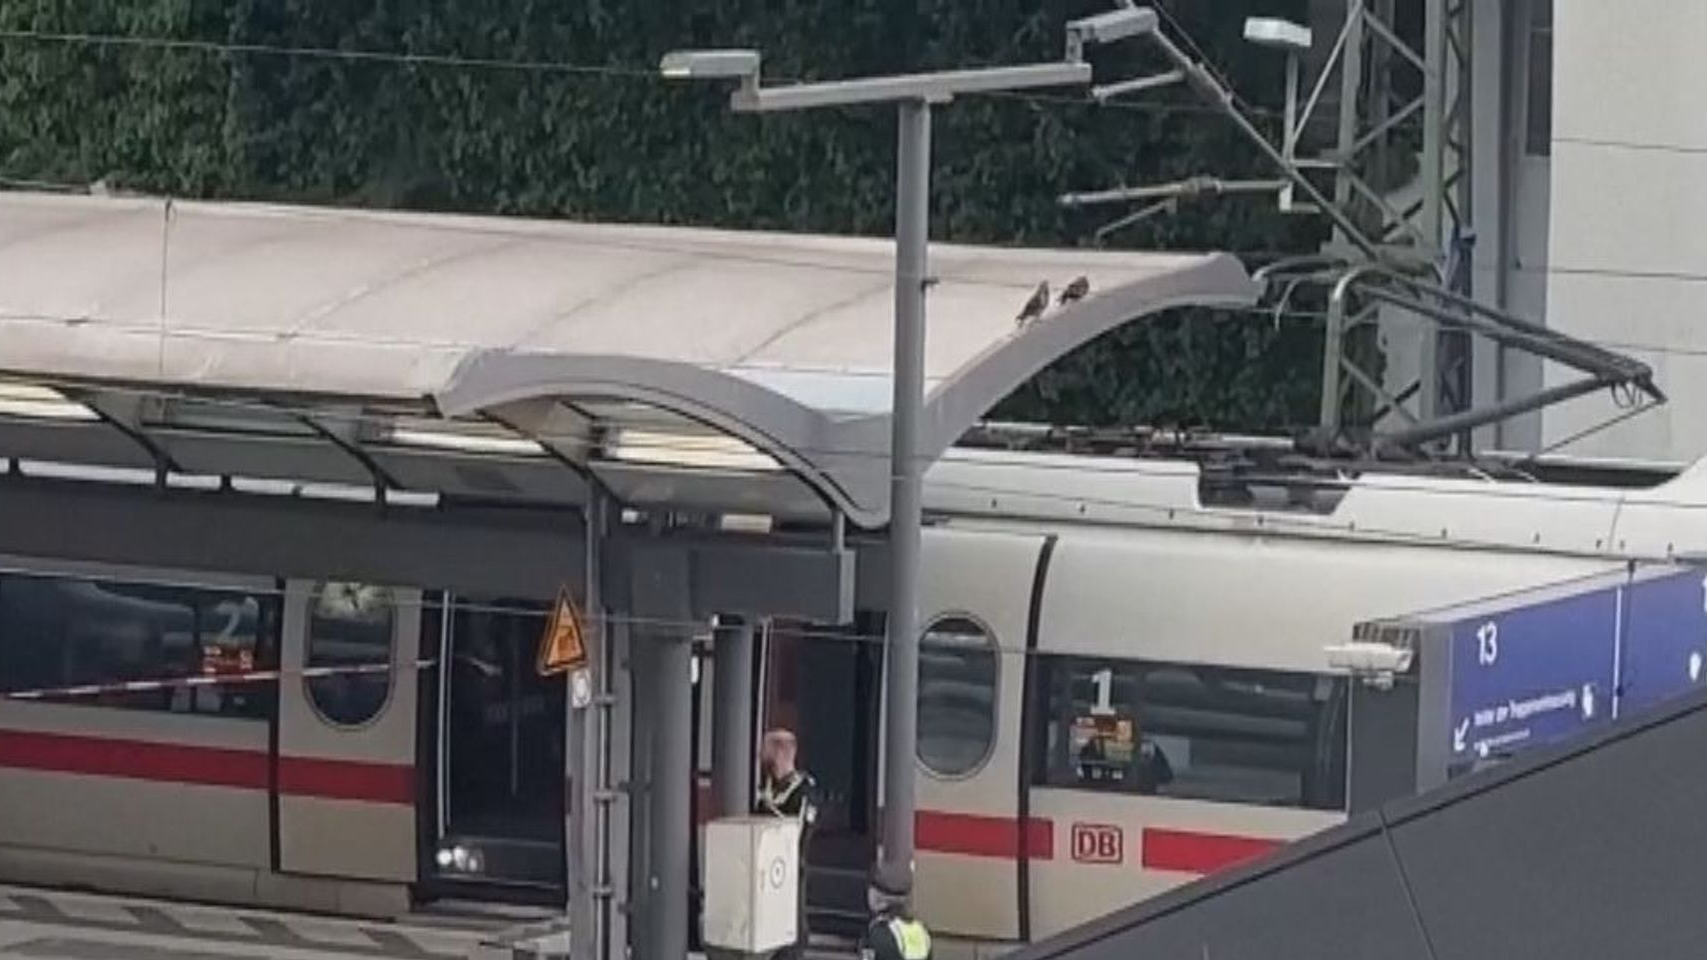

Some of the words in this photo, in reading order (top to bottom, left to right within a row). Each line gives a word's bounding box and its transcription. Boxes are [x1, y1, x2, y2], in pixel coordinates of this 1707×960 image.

[1476, 621, 1499, 666] 13
[1090, 669, 1116, 715] 1
[1076, 828, 1118, 859] DB
